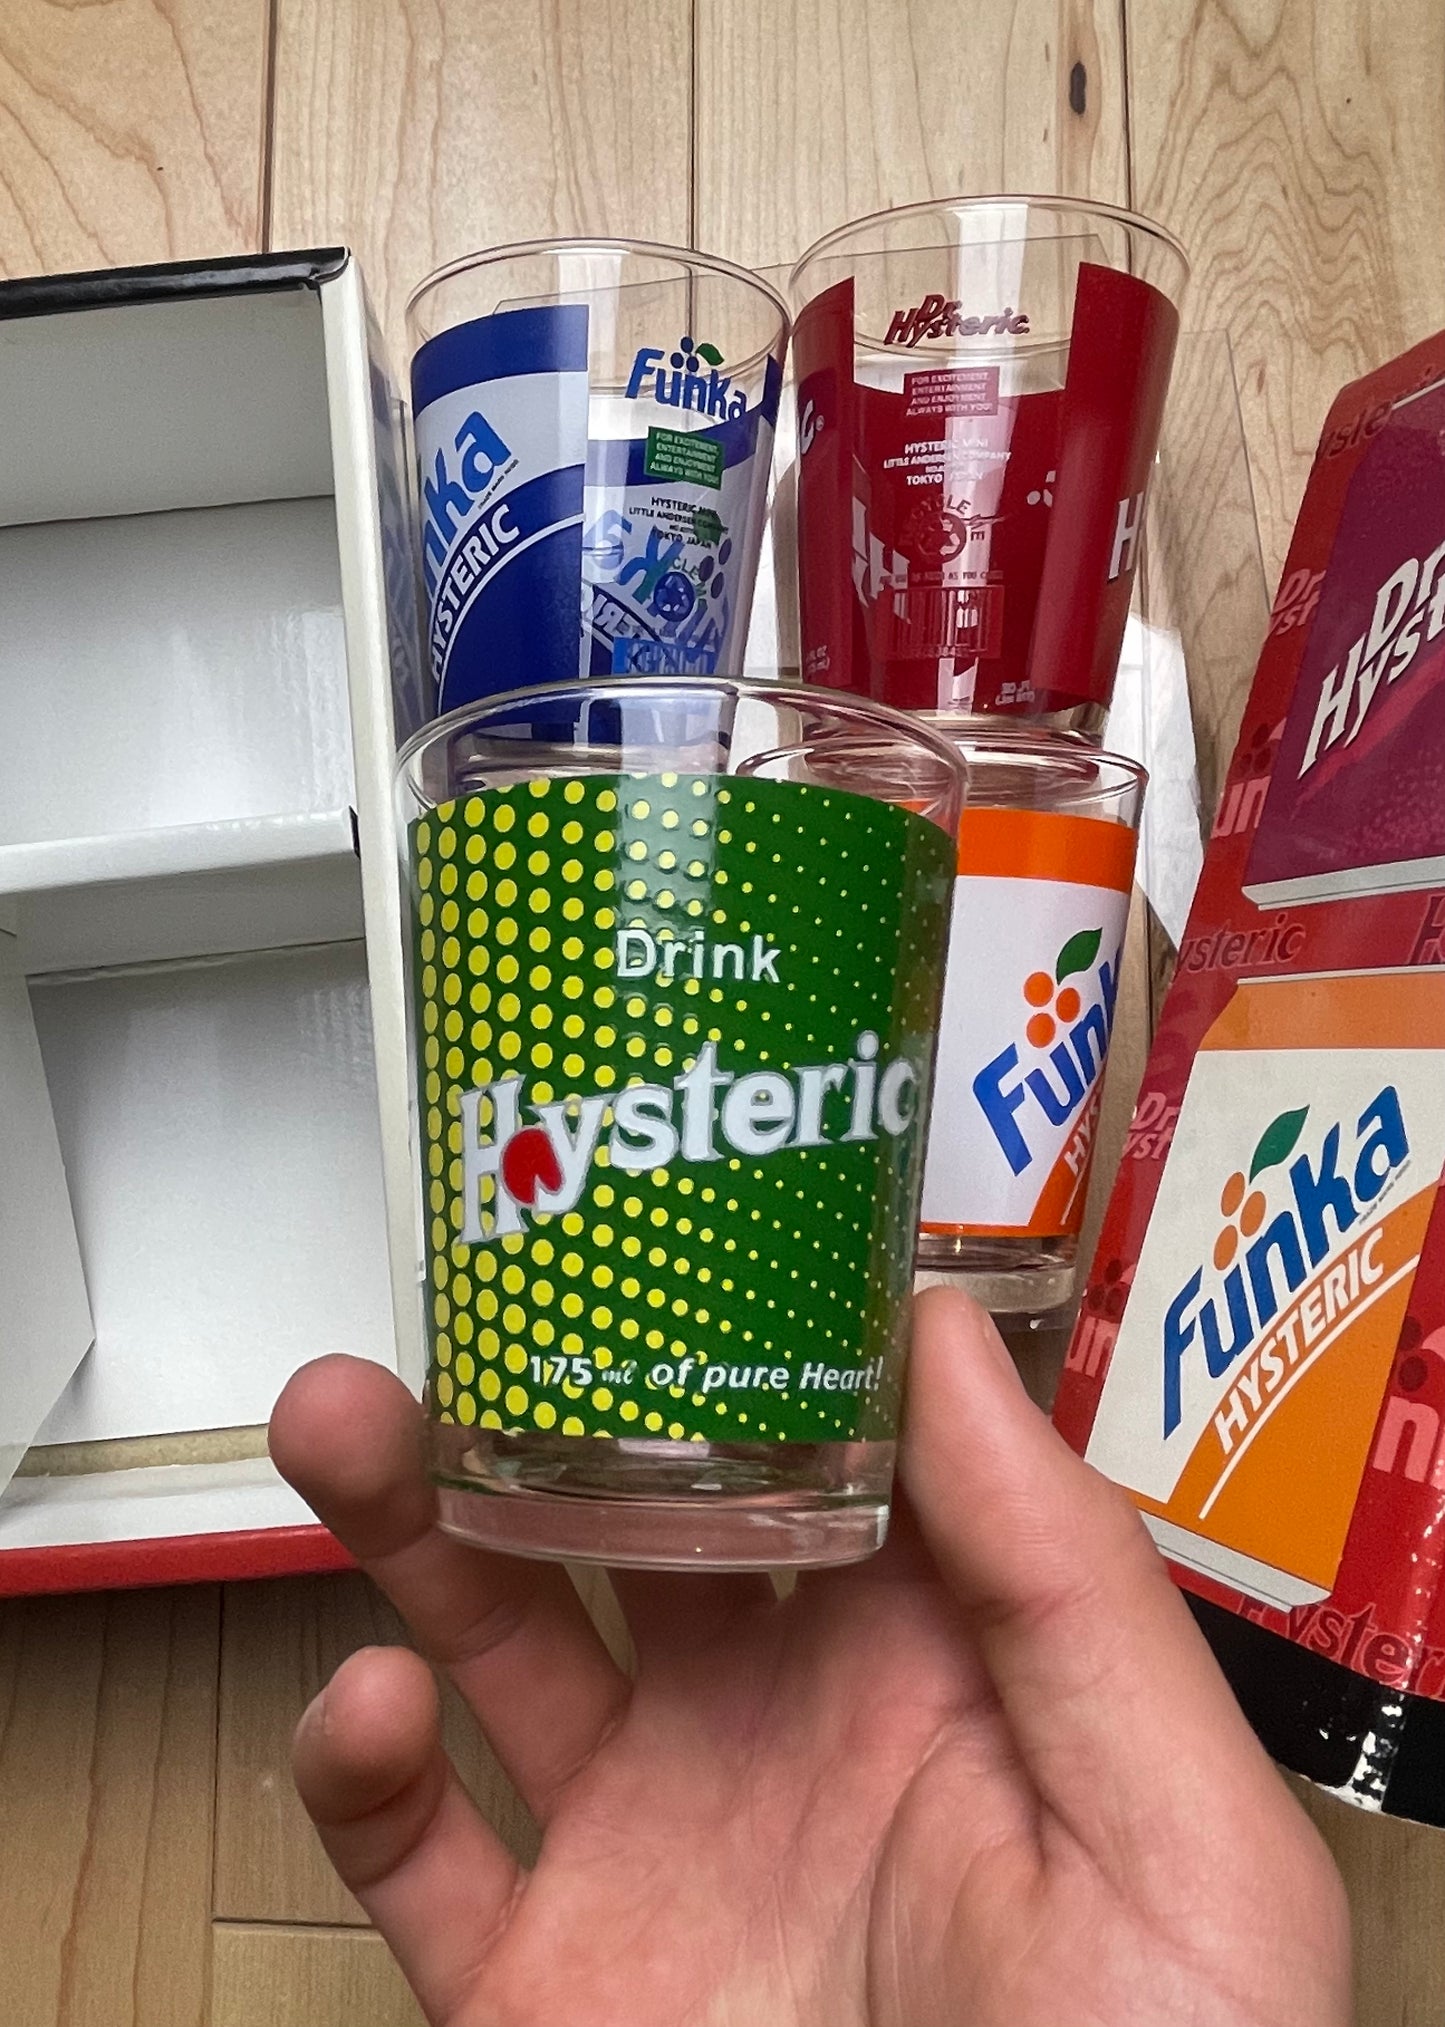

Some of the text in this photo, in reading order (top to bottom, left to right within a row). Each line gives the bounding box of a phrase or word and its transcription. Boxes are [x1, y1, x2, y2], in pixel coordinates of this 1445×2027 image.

[883, 307, 1031, 348] Hysteric
[625, 348, 747, 423] Funka
[912, 377, 930, 385] FOR
[912, 382, 987, 396] ENTERTAINMENT
[911, 392, 987, 406] AND ENJOYMENT
[906, 405, 944, 416] ALWAYS
[945, 404, 969, 413] WITH
[656, 432, 673, 442] FOR
[655, 453, 673, 463] AND
[649, 461, 684, 475] ALWAYS
[906, 473, 944, 486] TOKYO
[629, 507, 655, 518] LITTLE
[651, 497, 697, 514] HYSTERIC
[616, 929, 782, 984] Drink
[458, 1029, 922, 1245] Hysteric
[1163, 1085, 1410, 1441] Funka
[1213, 1227, 1386, 1455] HYSTERIC
[530, 1355, 593, 1386] 175
[651, 1356, 697, 1386] of
[702, 1365, 791, 1394] pure
[799, 1355, 884, 1392] Heart!
